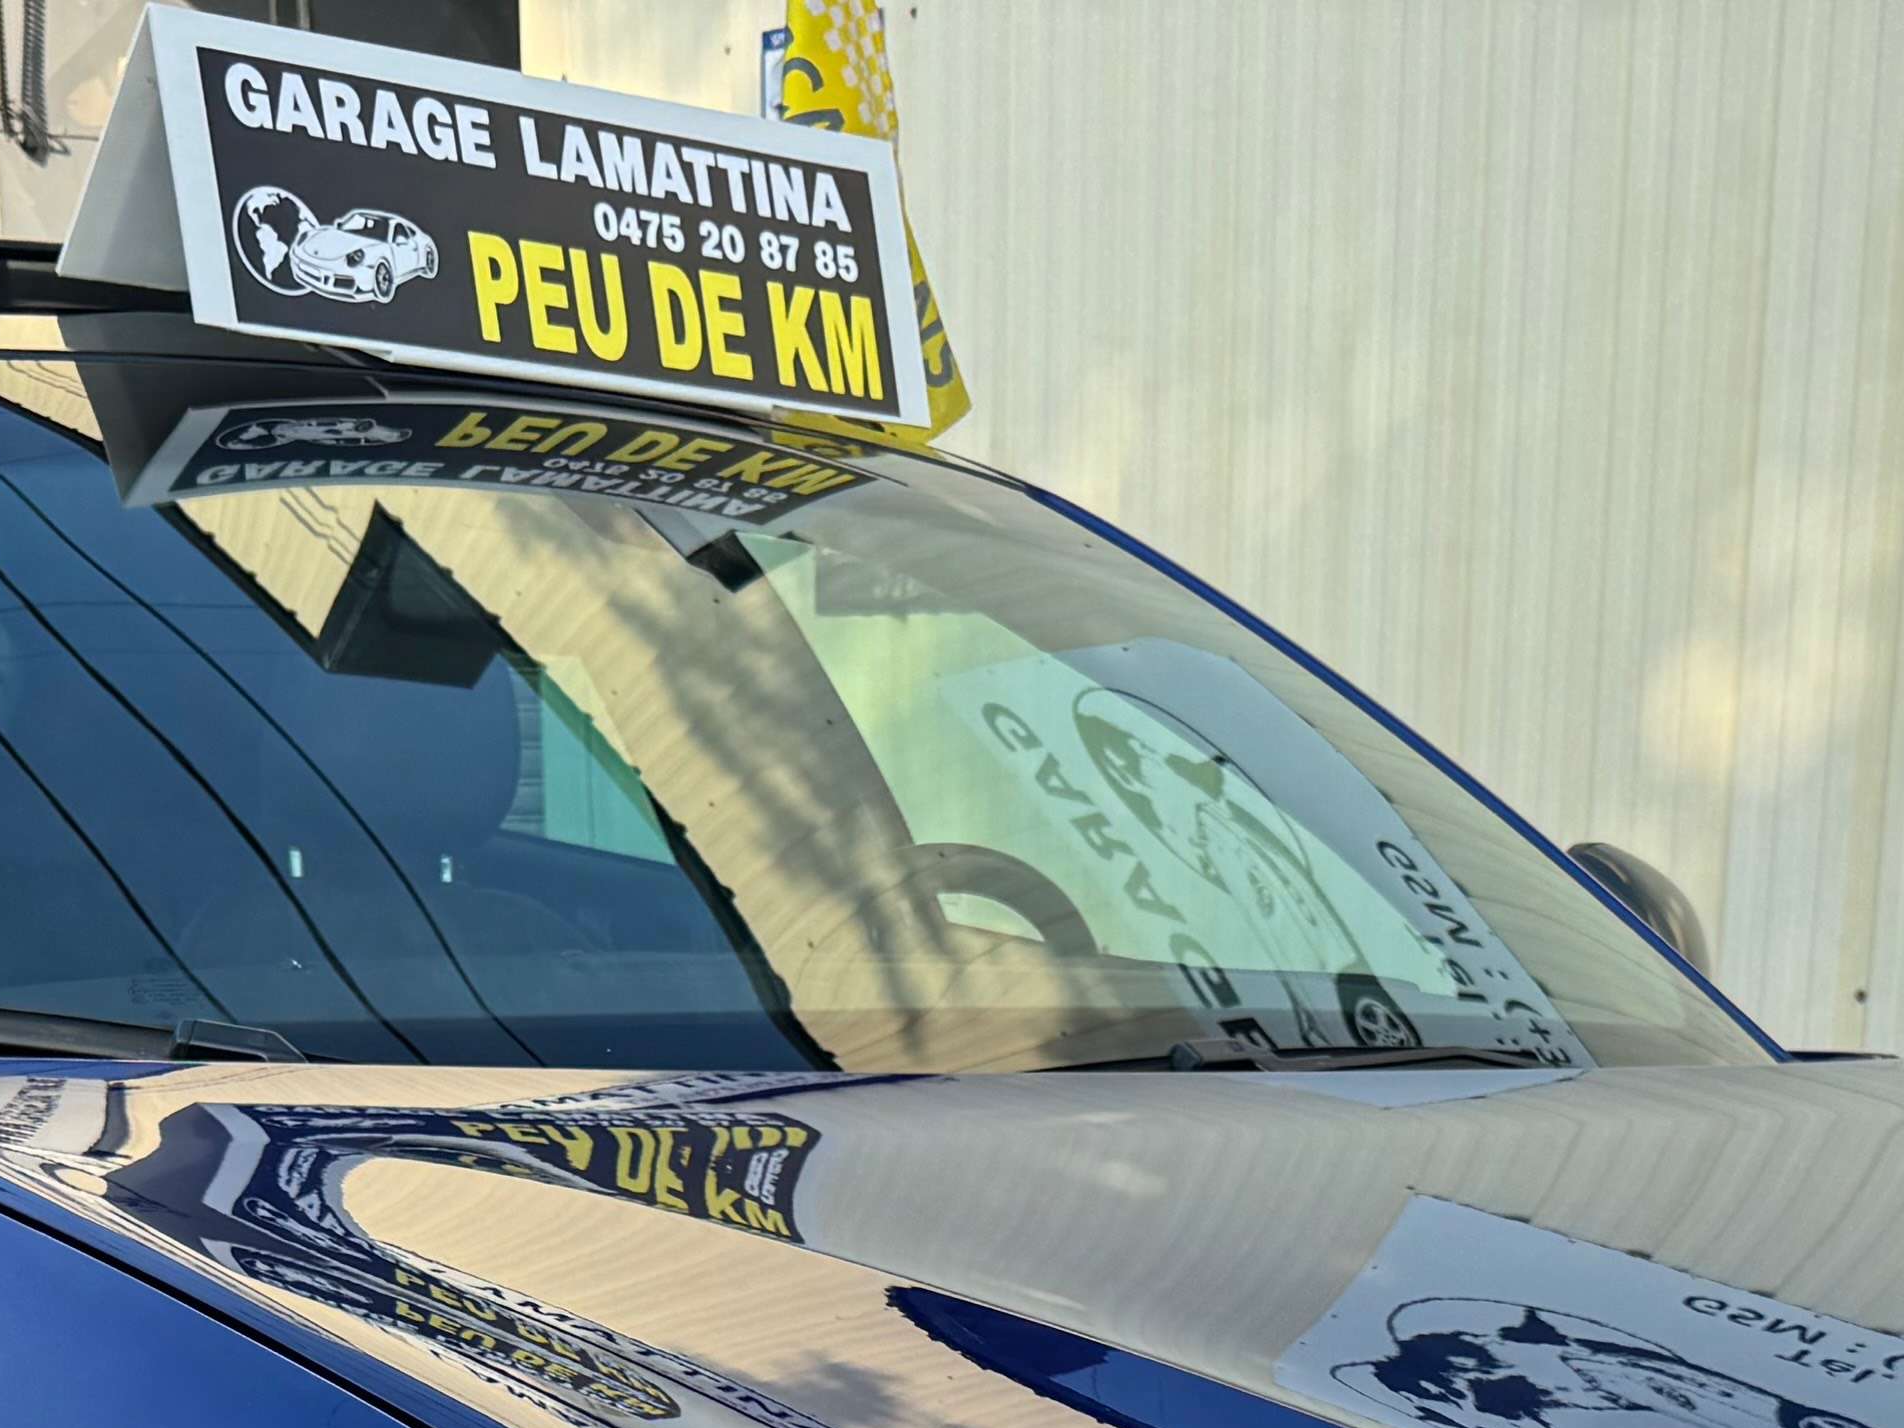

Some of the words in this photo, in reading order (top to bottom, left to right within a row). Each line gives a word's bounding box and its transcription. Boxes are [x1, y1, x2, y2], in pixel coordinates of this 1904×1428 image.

[225, 62, 496, 170] GARAGE
[517, 116, 853, 233] LAMATTINA
[467, 229, 628, 363] PEU
[647, 262, 754, 382] DE
[766, 281, 885, 401] KM
[593, 201, 685, 256] 0475
[698, 219, 746, 264] 20
[759, 231, 800, 273] 87
[813, 240, 859, 283] 85
